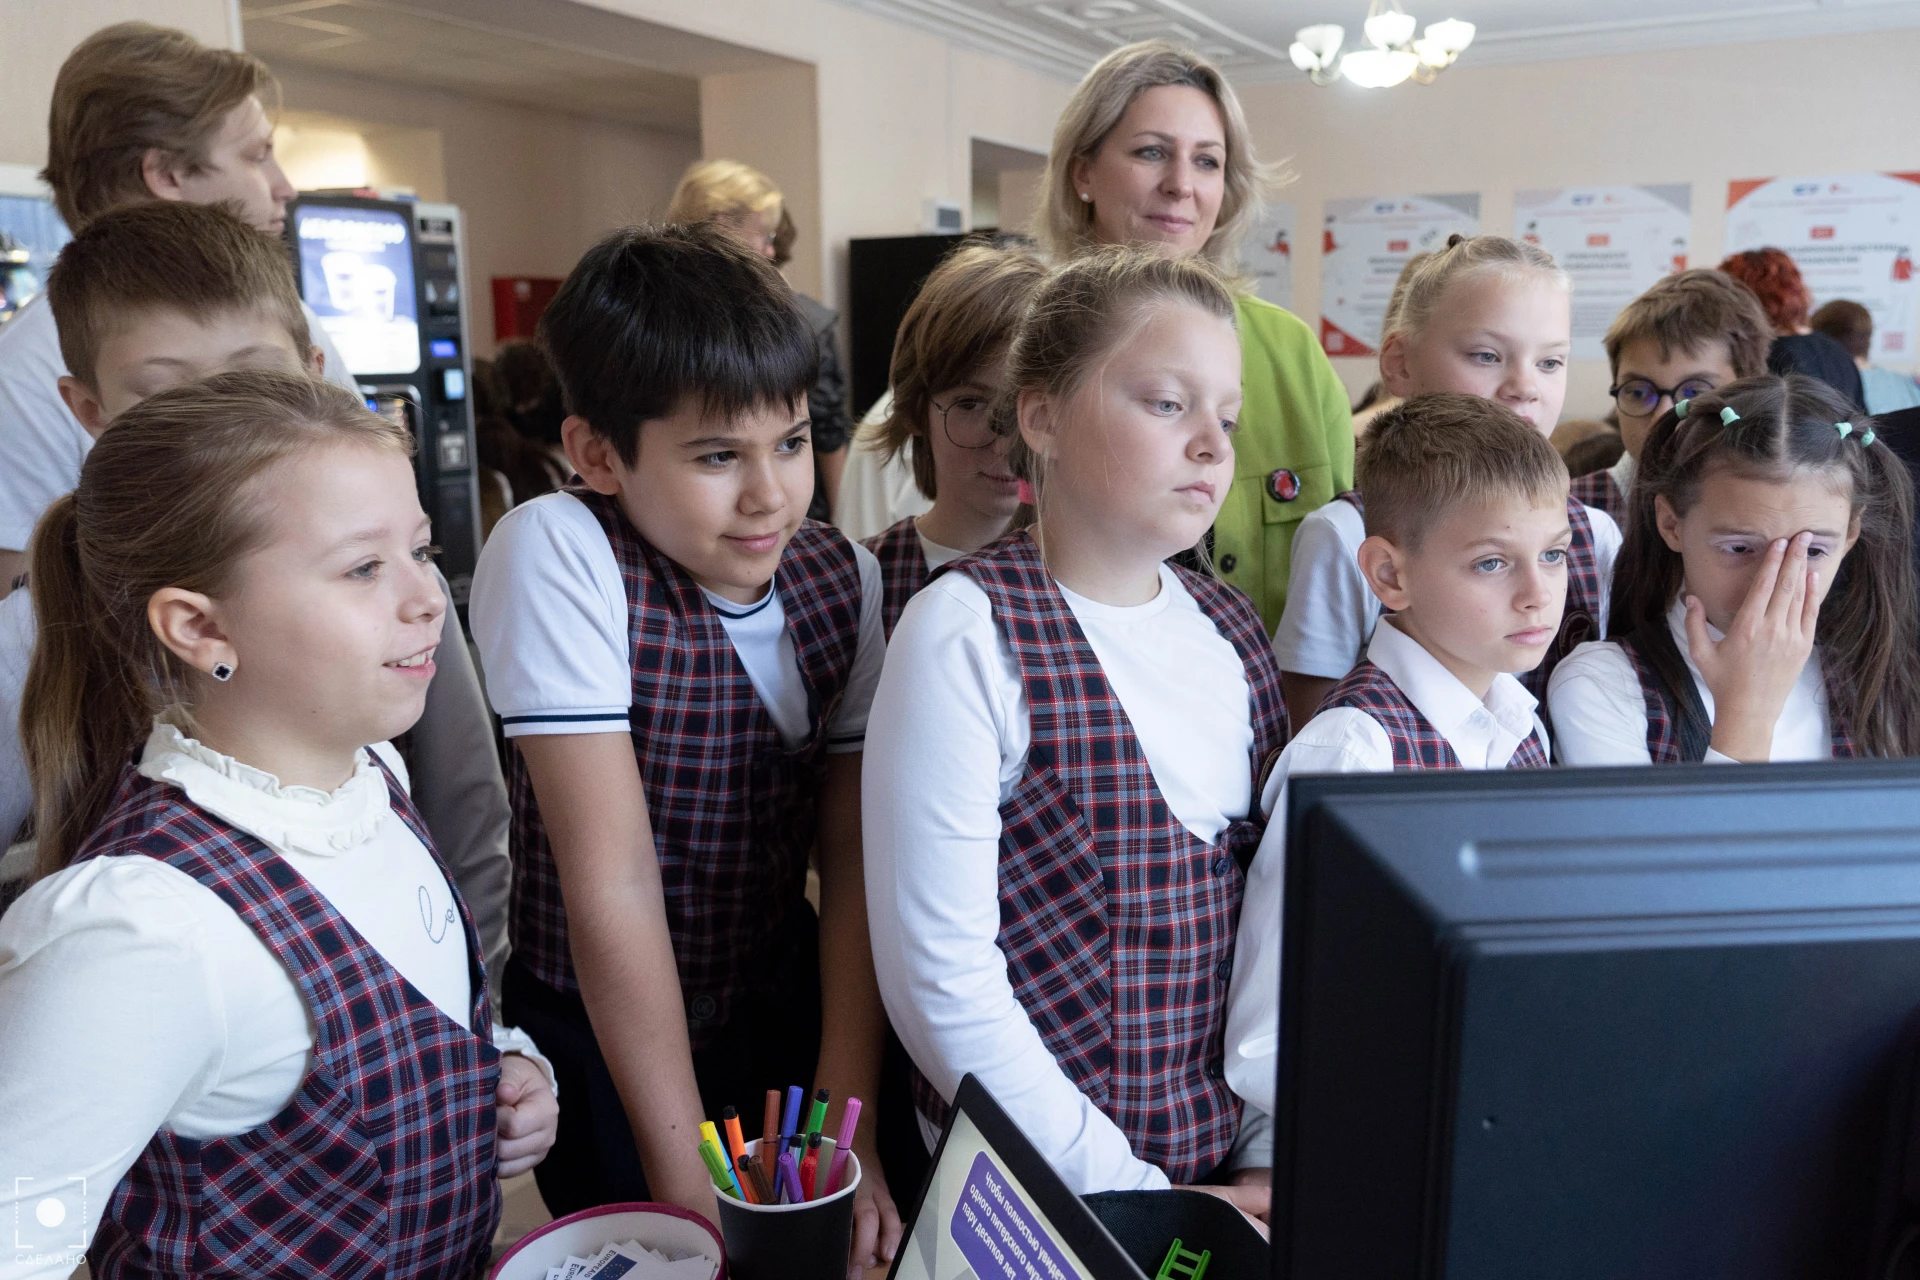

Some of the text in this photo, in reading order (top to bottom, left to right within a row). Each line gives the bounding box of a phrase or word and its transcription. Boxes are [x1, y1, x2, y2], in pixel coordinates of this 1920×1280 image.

[584, 1249, 617, 1278] EUROPEAID
[962, 1202, 1017, 1280] пару десятков лет
[970, 1184, 1044, 1280] одного питерского муз
[985, 1171, 1067, 1280] Чтобы полностью увидет
[564, 1263, 580, 1280] EURO
